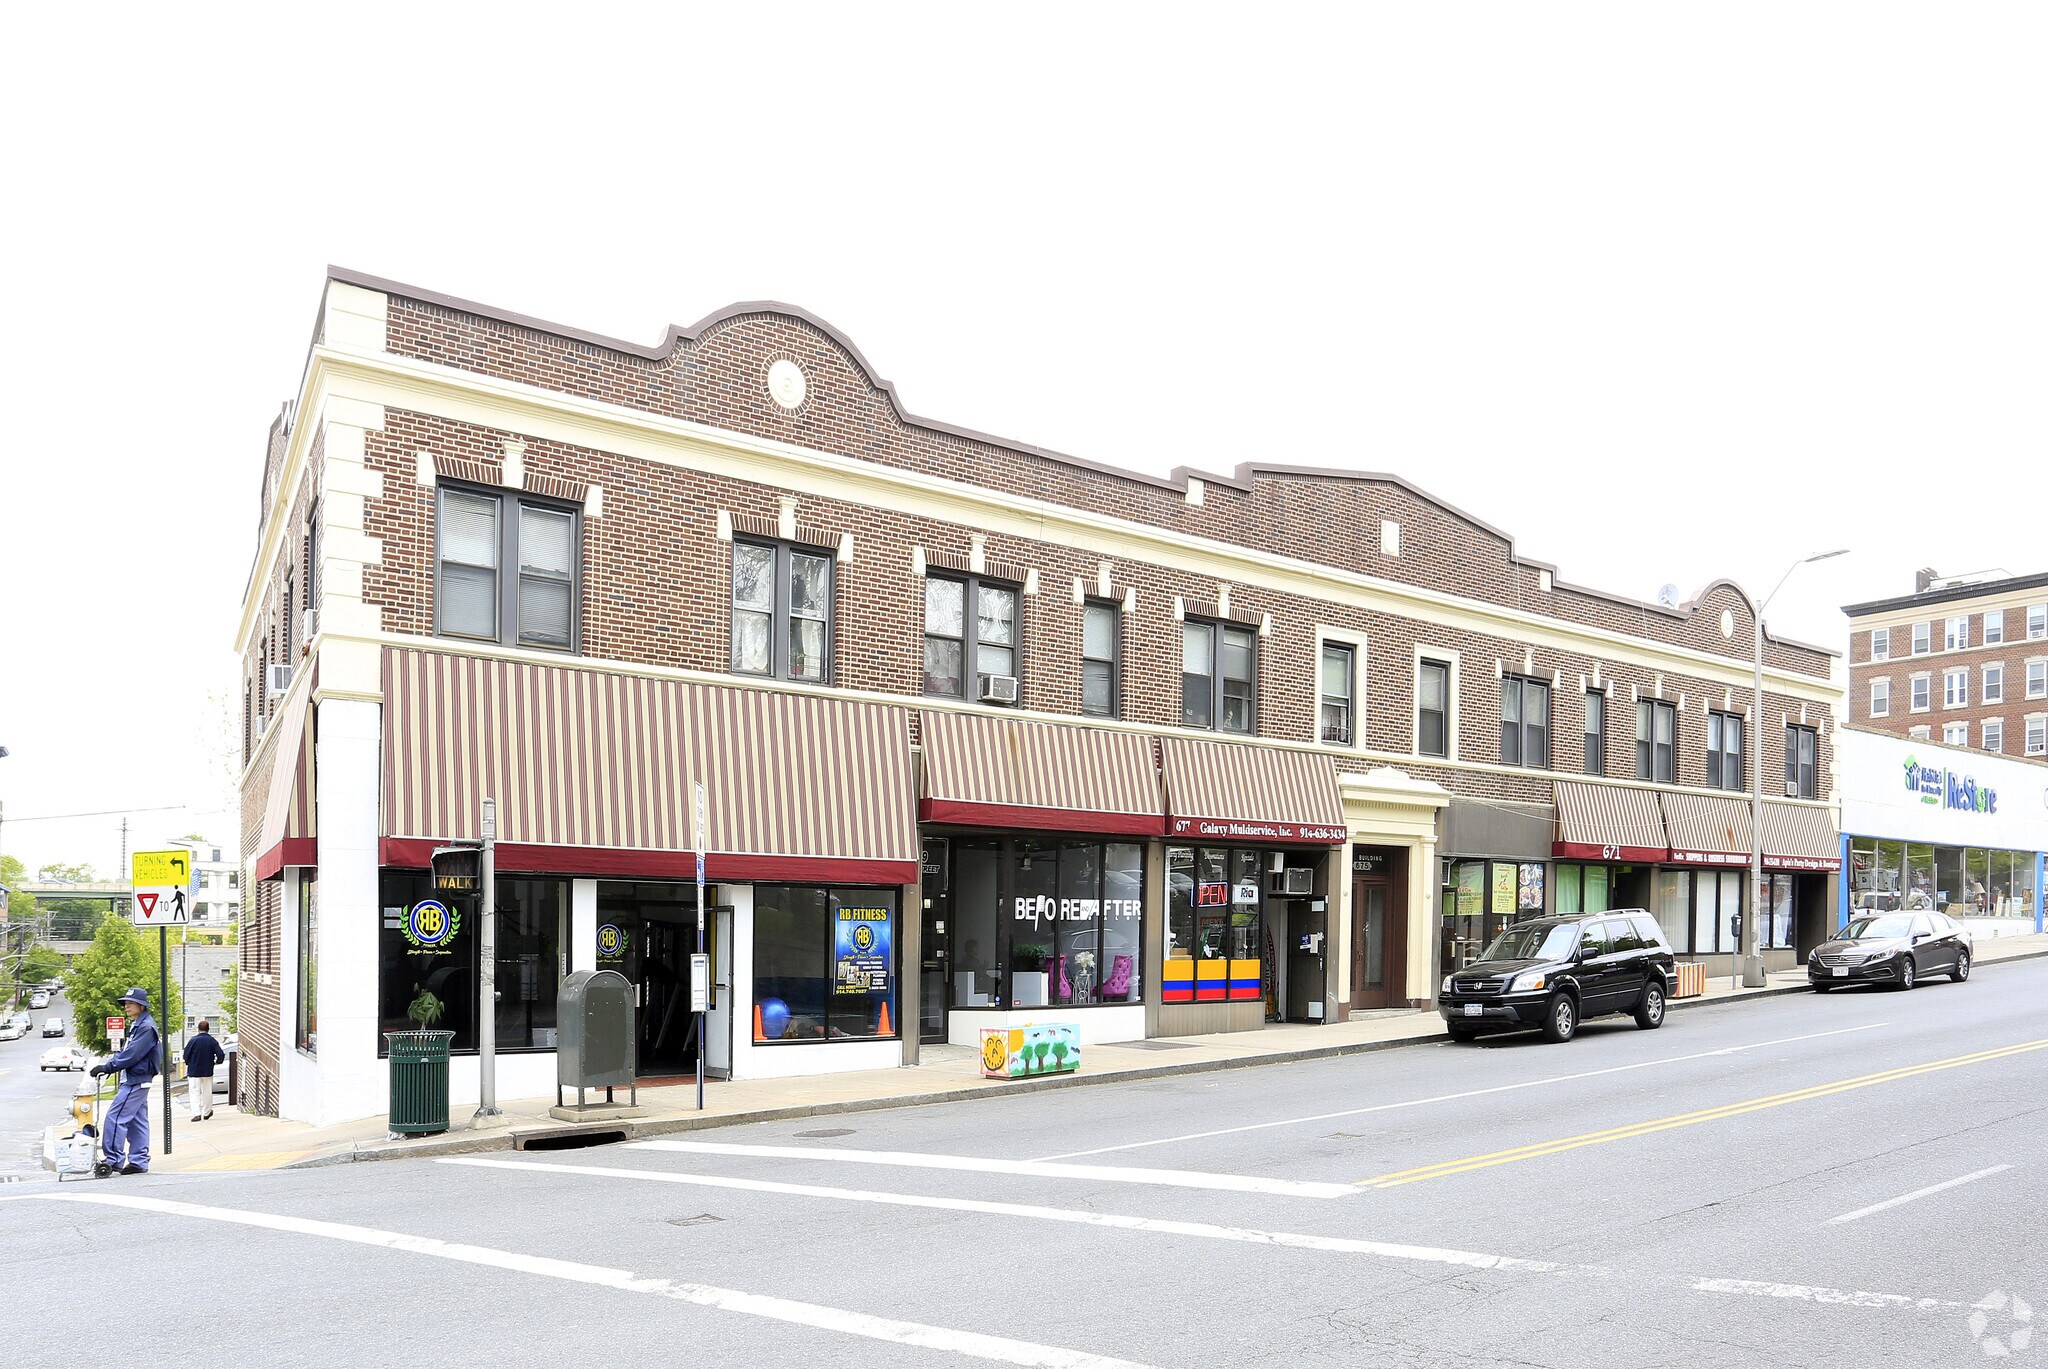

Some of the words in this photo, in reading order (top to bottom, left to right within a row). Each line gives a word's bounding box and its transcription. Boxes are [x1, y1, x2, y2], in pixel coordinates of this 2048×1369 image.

[1947, 772, 1997, 814] ReStore
[1200, 821, 1228, 837] Galaxy
[1278, 826, 1293, 837] Inc.
[1358, 854, 1383, 862] BUILDING
[1603, 845, 1621, 860] 671
[135, 855, 166, 867] TURNING
[135, 868, 168, 880] VEHICLES
[438, 876, 473, 889] WALK
[1241, 887, 1254, 898] Ria
[160, 901, 170, 912] TO
[840, 908, 851, 921] RB
[853, 908, 887, 921] FITNESS
